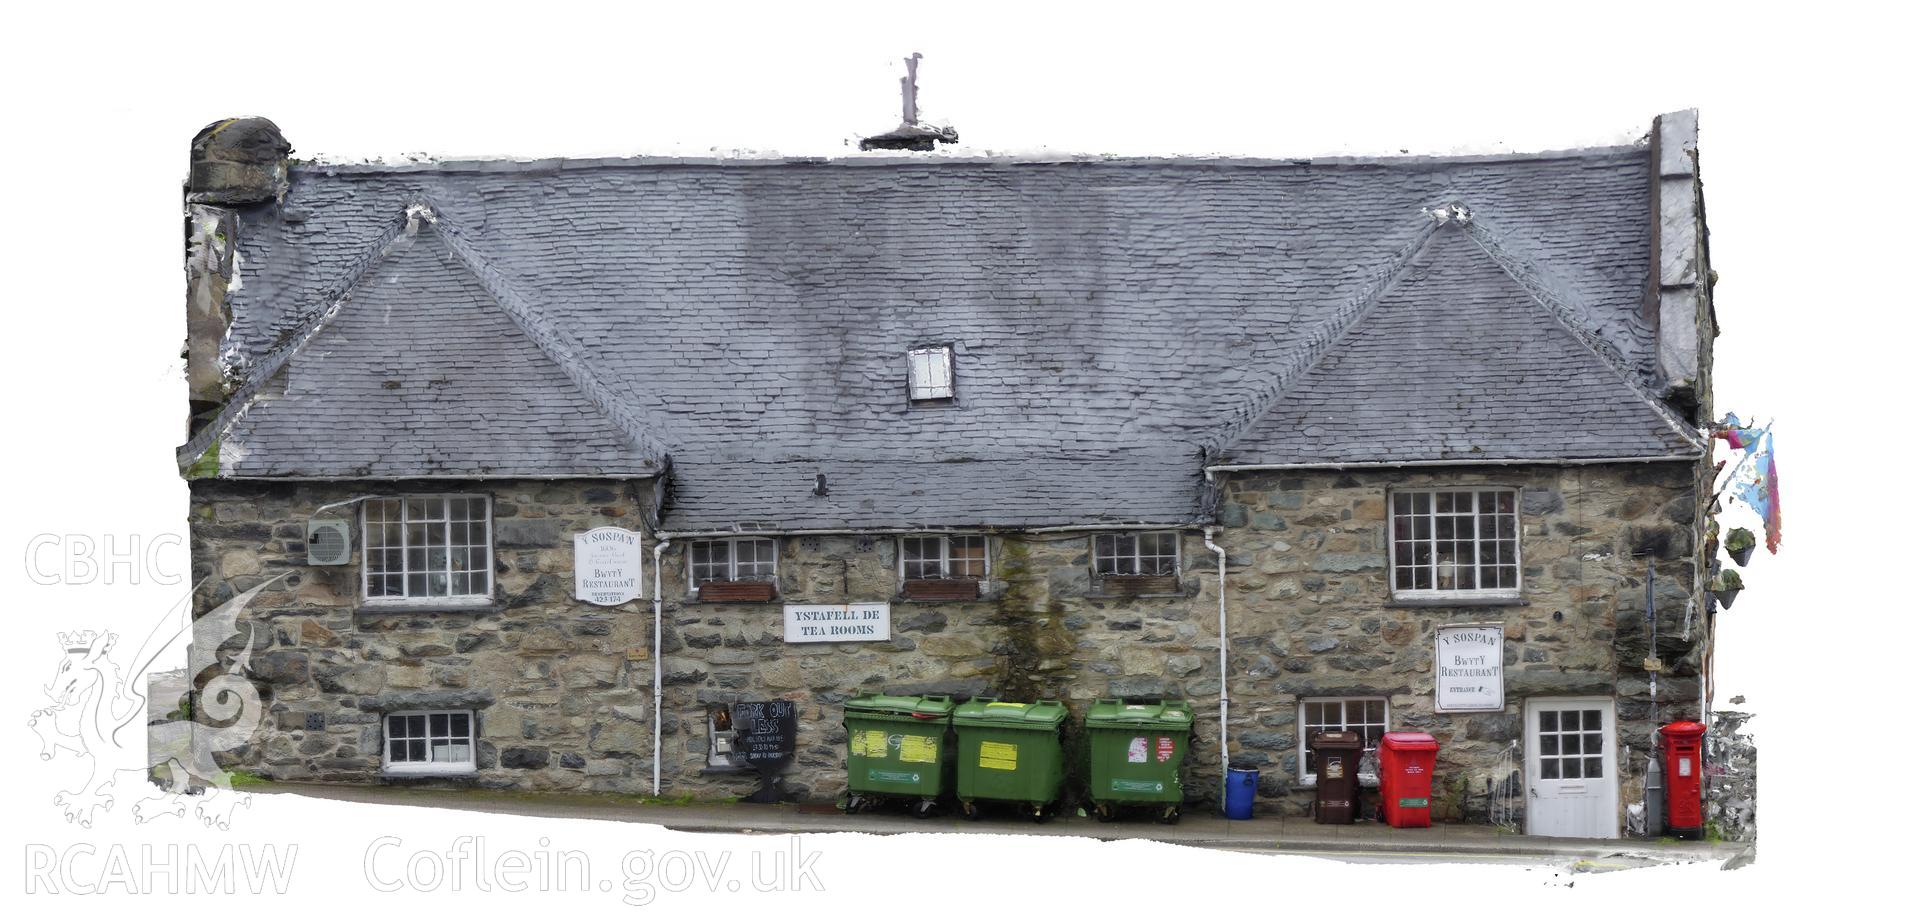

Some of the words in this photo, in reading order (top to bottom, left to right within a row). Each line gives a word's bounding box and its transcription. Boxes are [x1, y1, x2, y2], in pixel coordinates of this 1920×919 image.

[583, 536, 588, 544] Y
[592, 532, 634, 545] SOSPAN
[795, 611, 858, 621] YSTAFELL
[863, 610, 880, 620] DE
[801, 626, 826, 636] TEA
[830, 624, 875, 636] ROOMS
[1442, 636, 1450, 645] Y
[1453, 632, 1497, 646] SOSPAN
